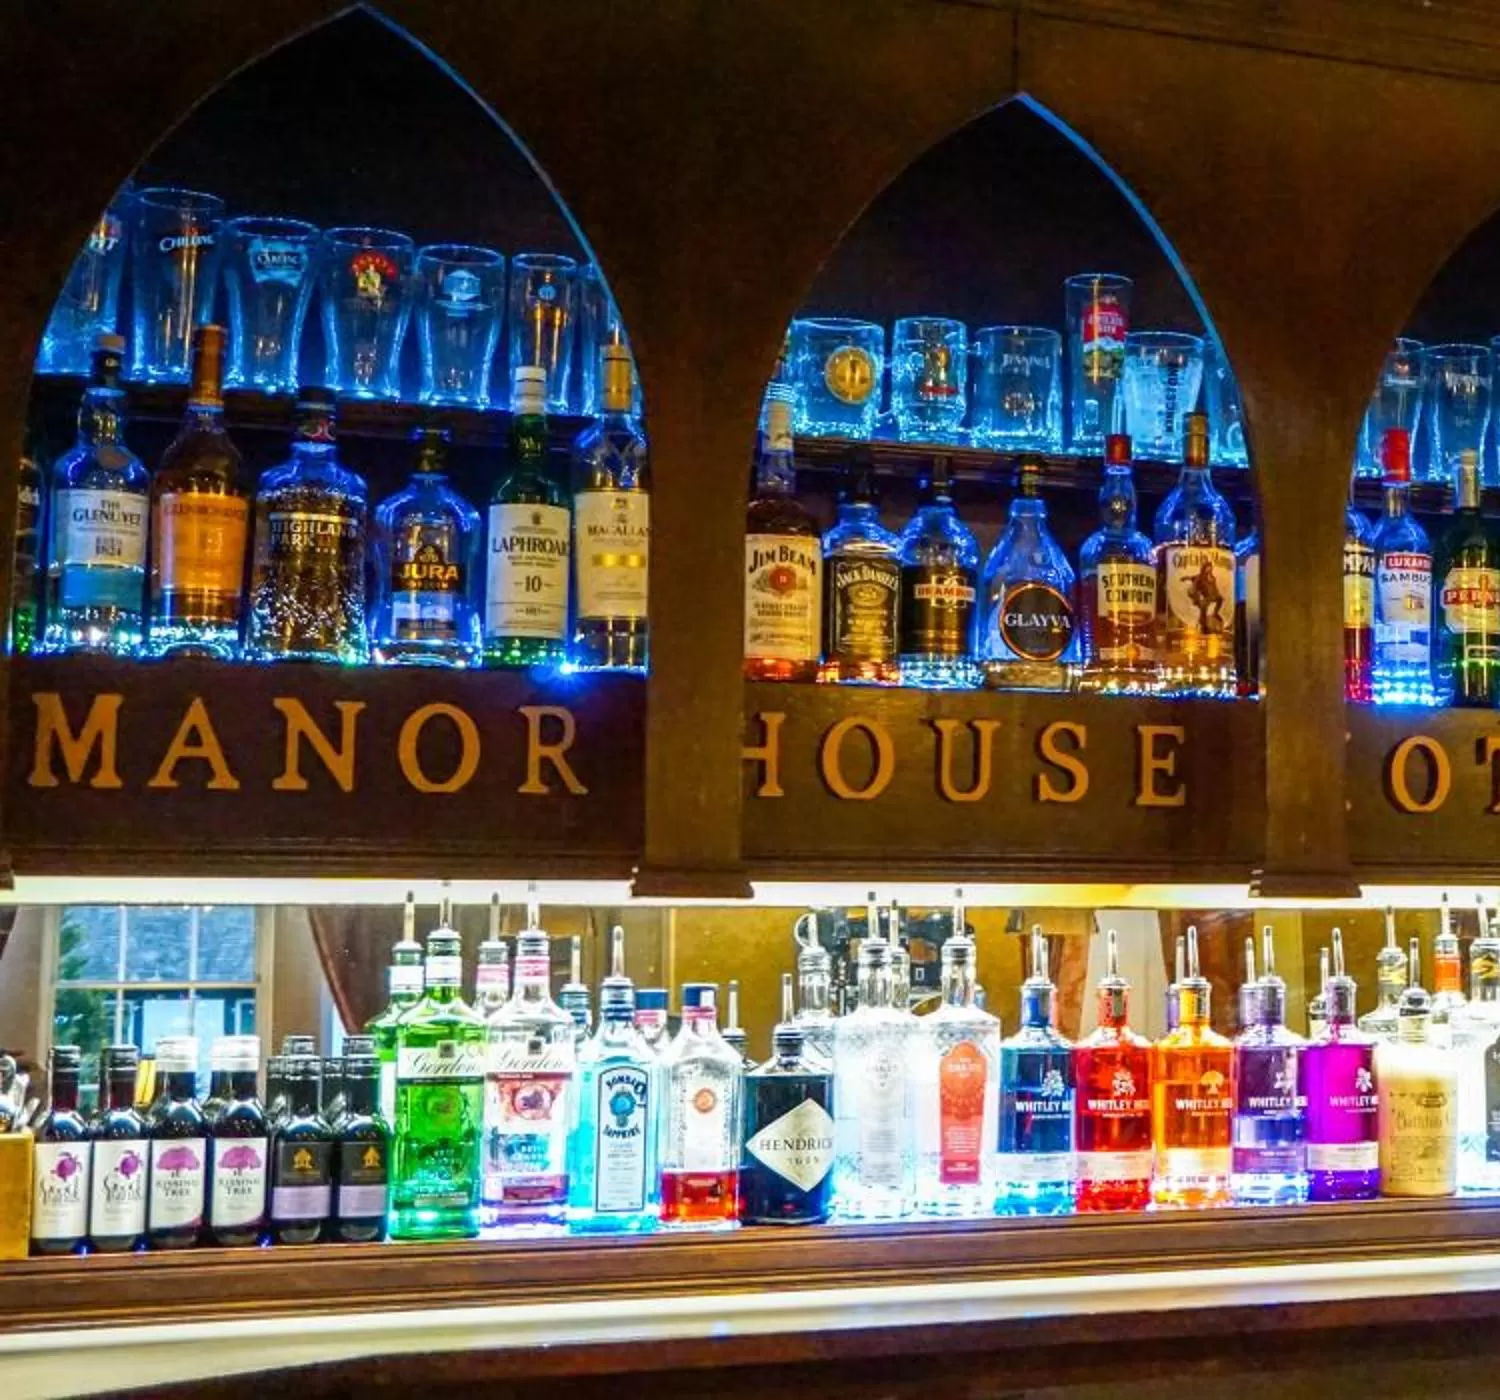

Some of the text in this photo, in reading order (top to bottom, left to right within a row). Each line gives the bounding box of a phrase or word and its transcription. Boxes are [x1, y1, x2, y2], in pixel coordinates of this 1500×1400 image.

[749, 550, 776, 574] JIM
[401, 565, 458, 581] JURA
[525, 576, 542, 592] 10
[1005, 612, 1071, 629] GLAYVA
[27, 693, 589, 795] MANOR
[740, 711, 1187, 807] HOUSE
